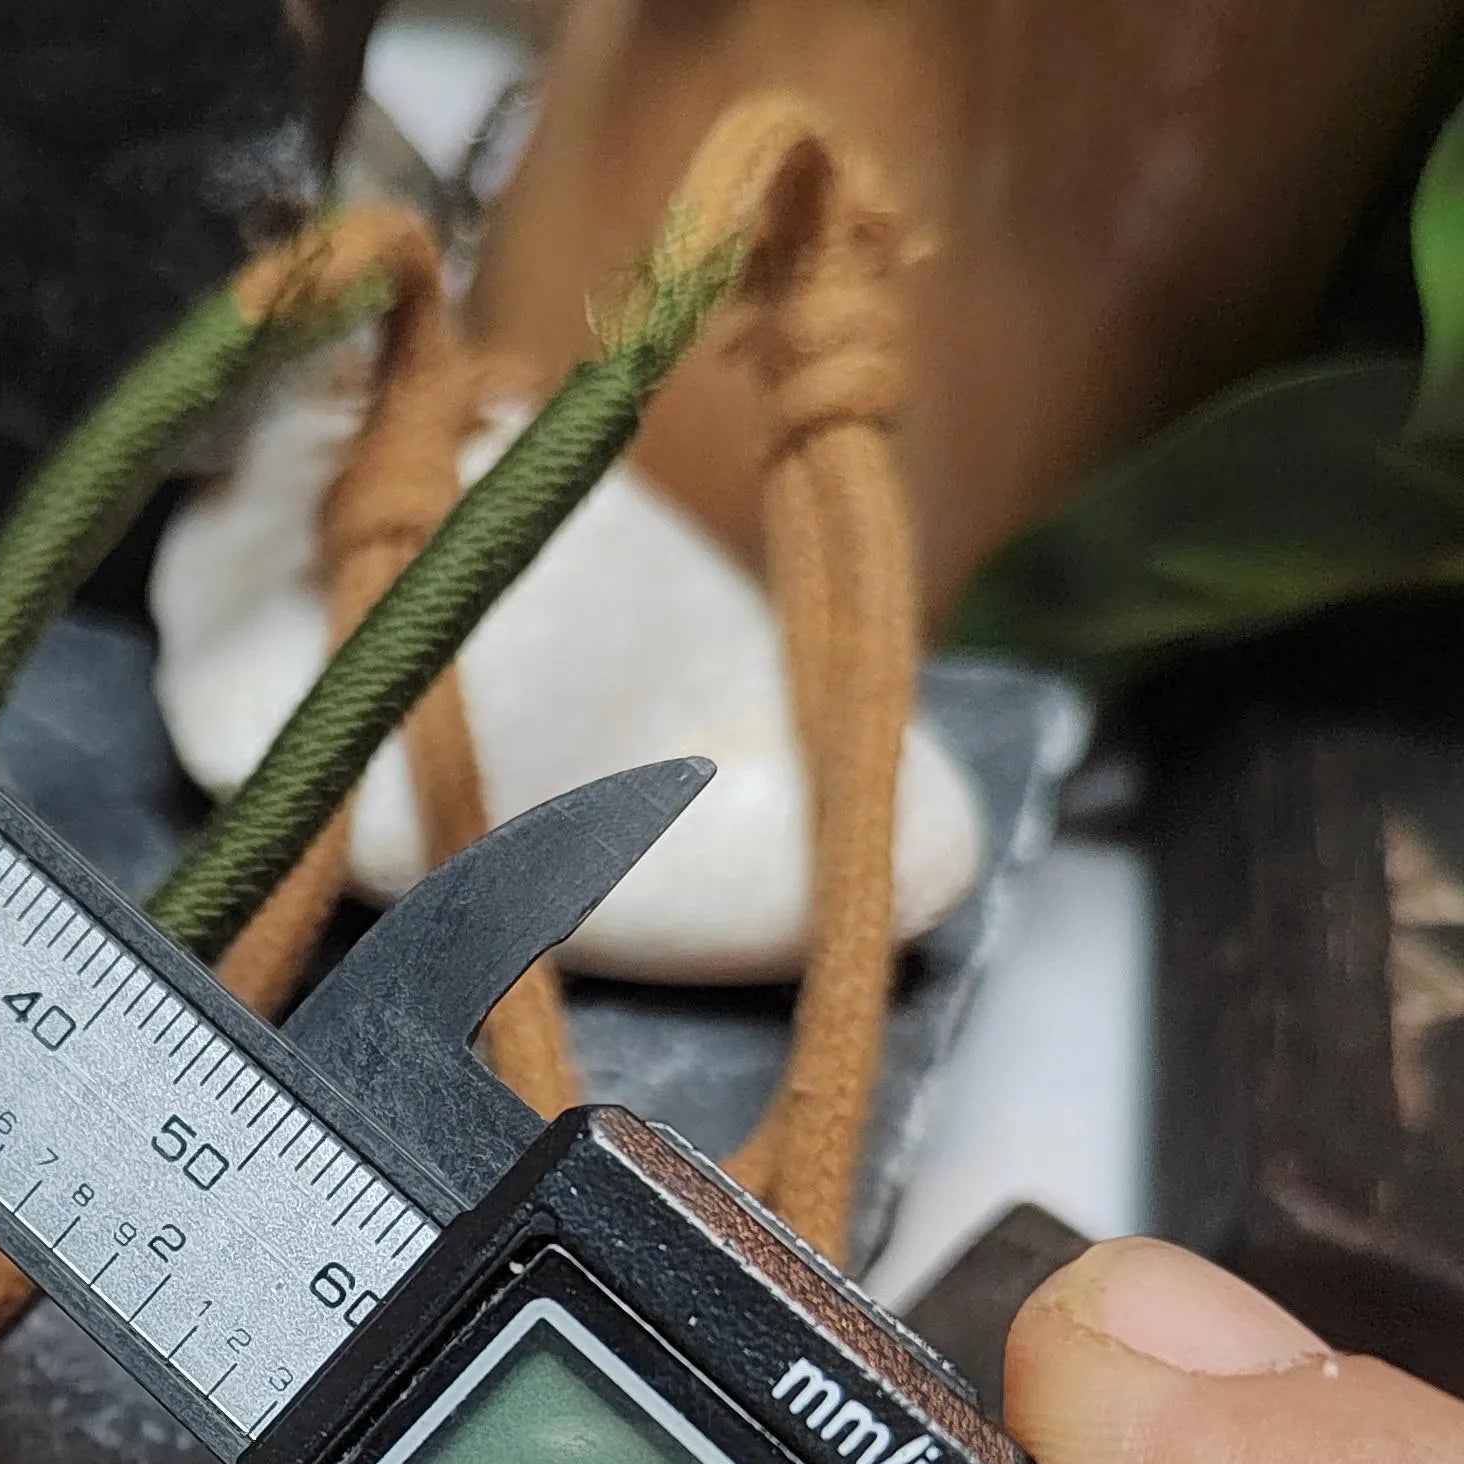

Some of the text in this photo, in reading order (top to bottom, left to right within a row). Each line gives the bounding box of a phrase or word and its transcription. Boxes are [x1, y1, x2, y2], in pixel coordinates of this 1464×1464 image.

[3, 991, 77, 1051] 40
[151, 1114, 230, 1191] 50
[36, 1147, 59, 1168] 7
[71, 1183, 95, 1207] 8
[113, 1221, 137, 1246] 9
[148, 1224, 187, 1262] 2
[227, 1328, 252, 1351] 2
[269, 1366, 293, 1391] 3
